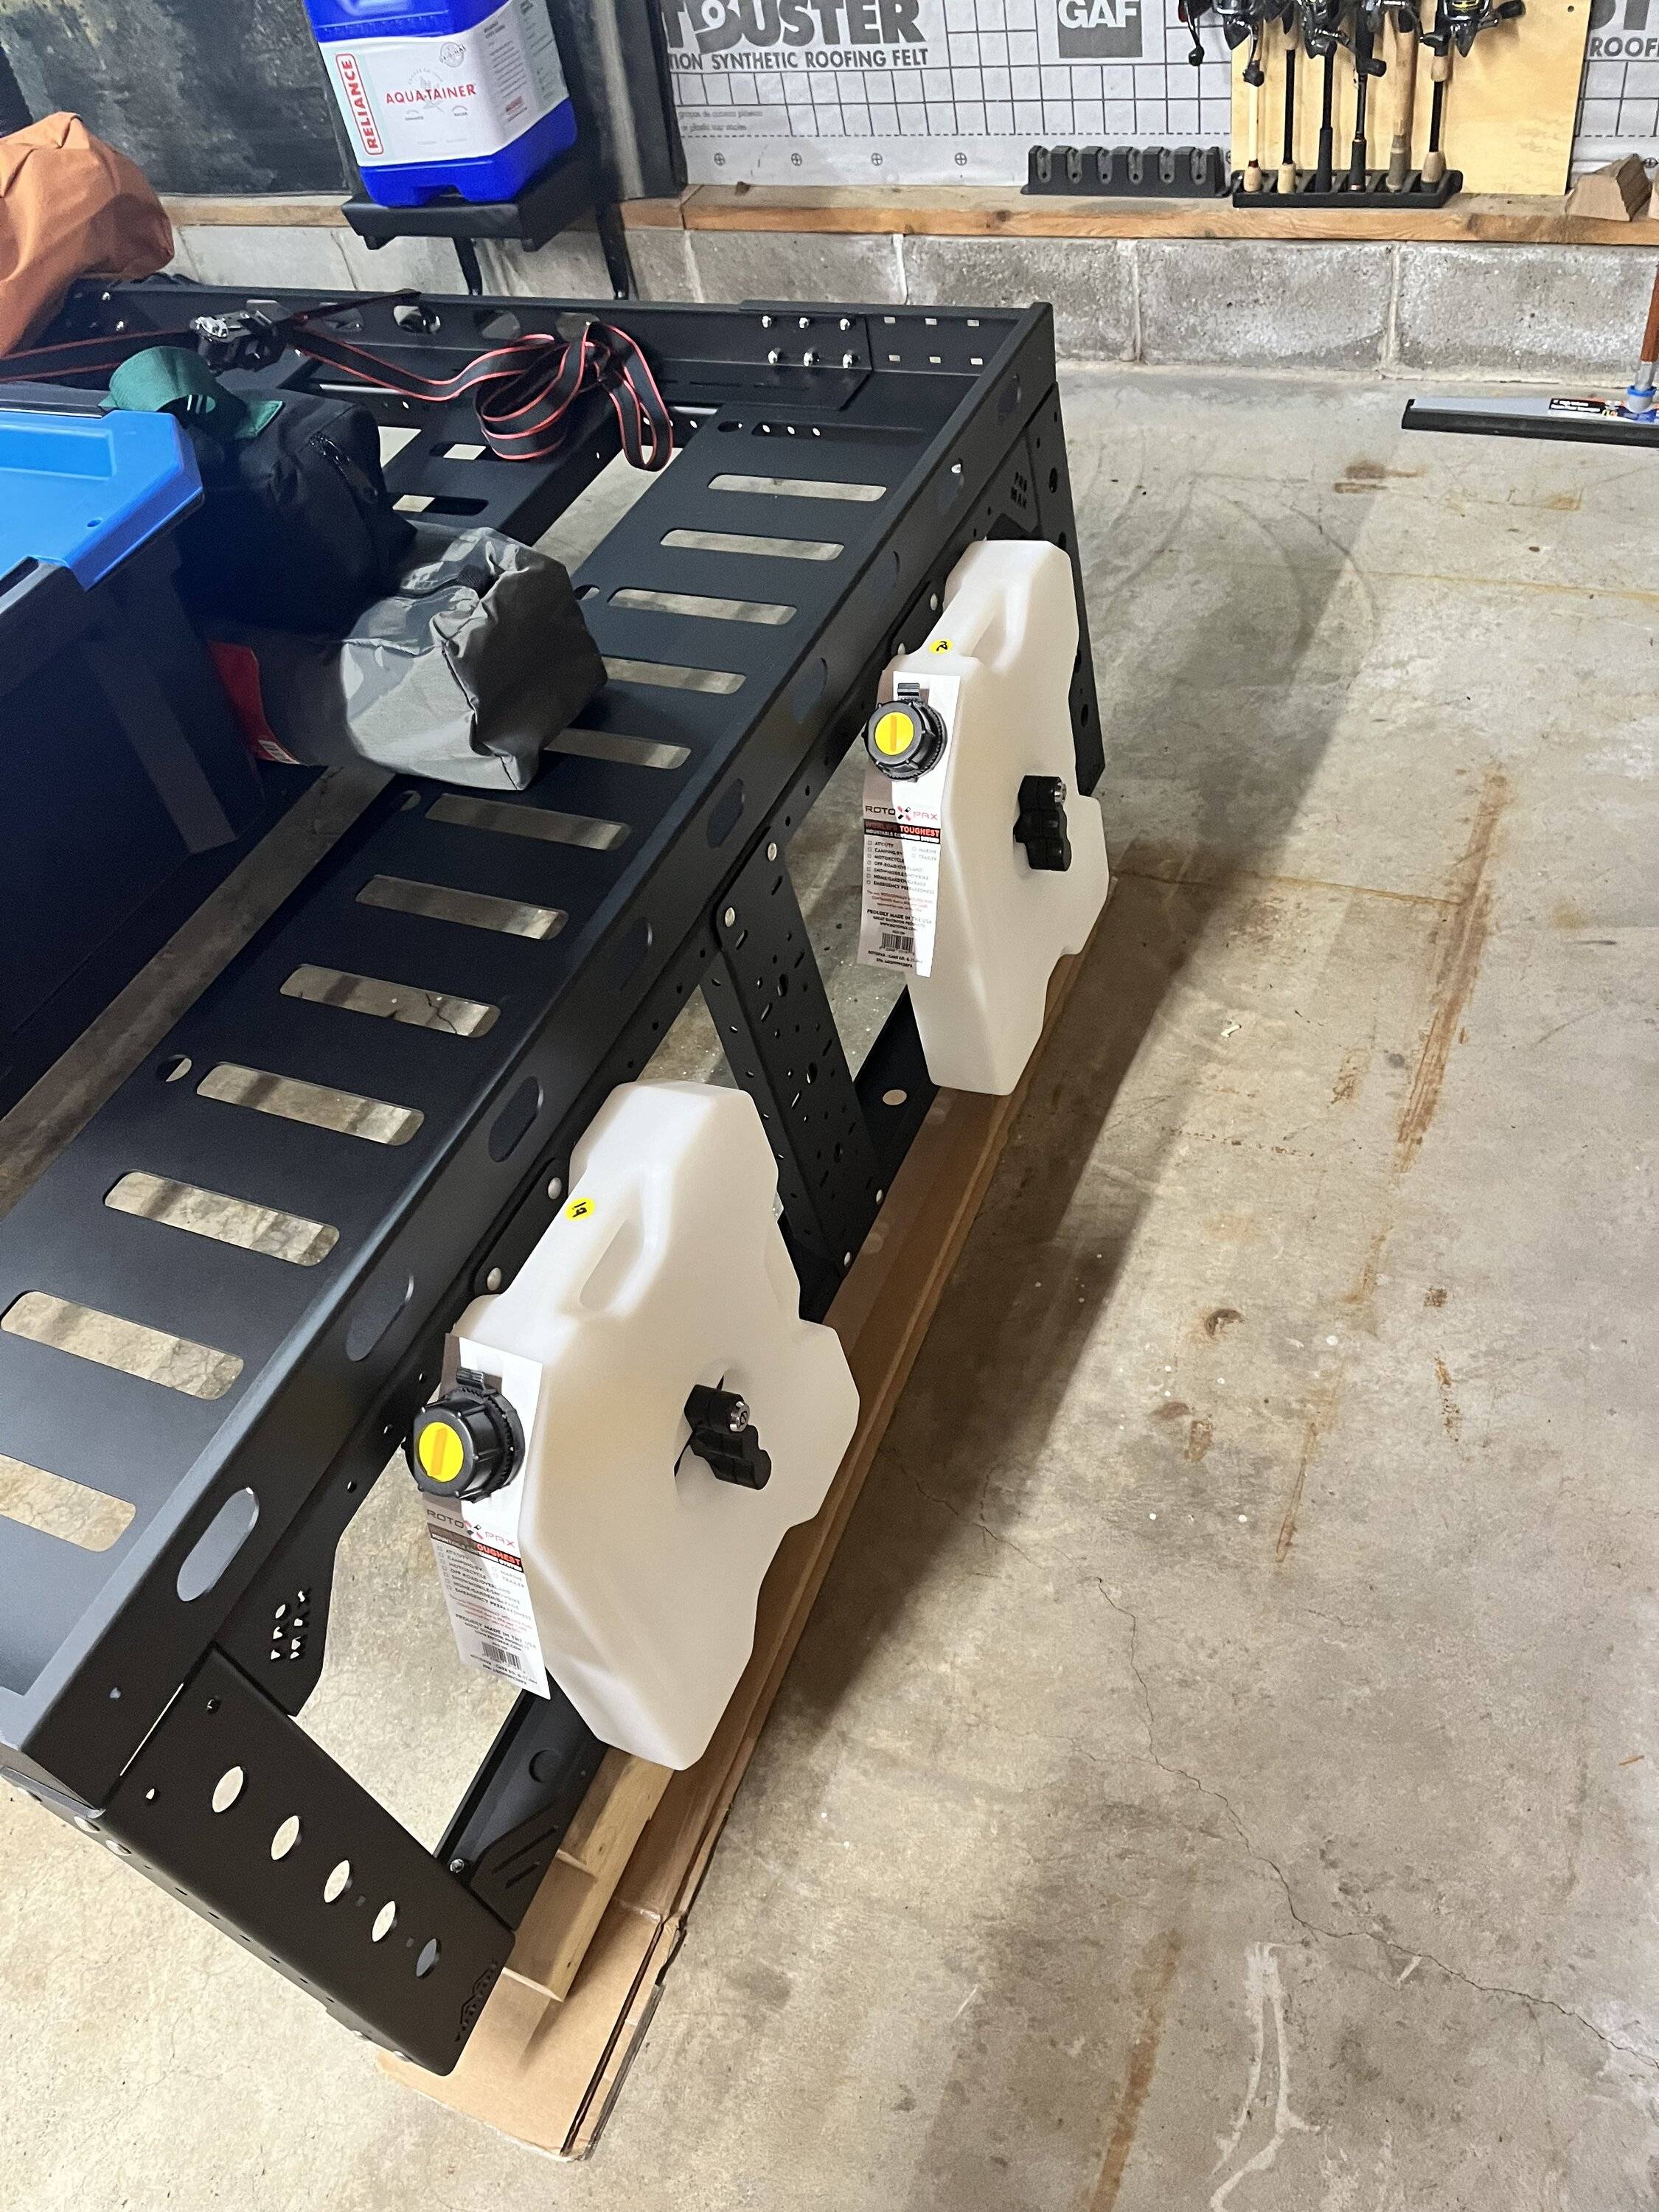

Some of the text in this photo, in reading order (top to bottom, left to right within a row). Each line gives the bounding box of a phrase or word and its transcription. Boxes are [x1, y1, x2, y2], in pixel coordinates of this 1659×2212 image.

[1058, 0, 1140, 28] GAF
[712, 52, 798, 70] SYNTHETIC
[805, 50, 886, 68] ROOFING
[892, 48, 928, 66] FELT
[341, 59, 379, 148] RELIANCE
[865, 805, 895, 815] ROTO
[900, 825, 939, 837] TOUGHEST
[425, 1508, 465, 1528] ROTO
[476, 1543, 521, 1566] OUGHEST
